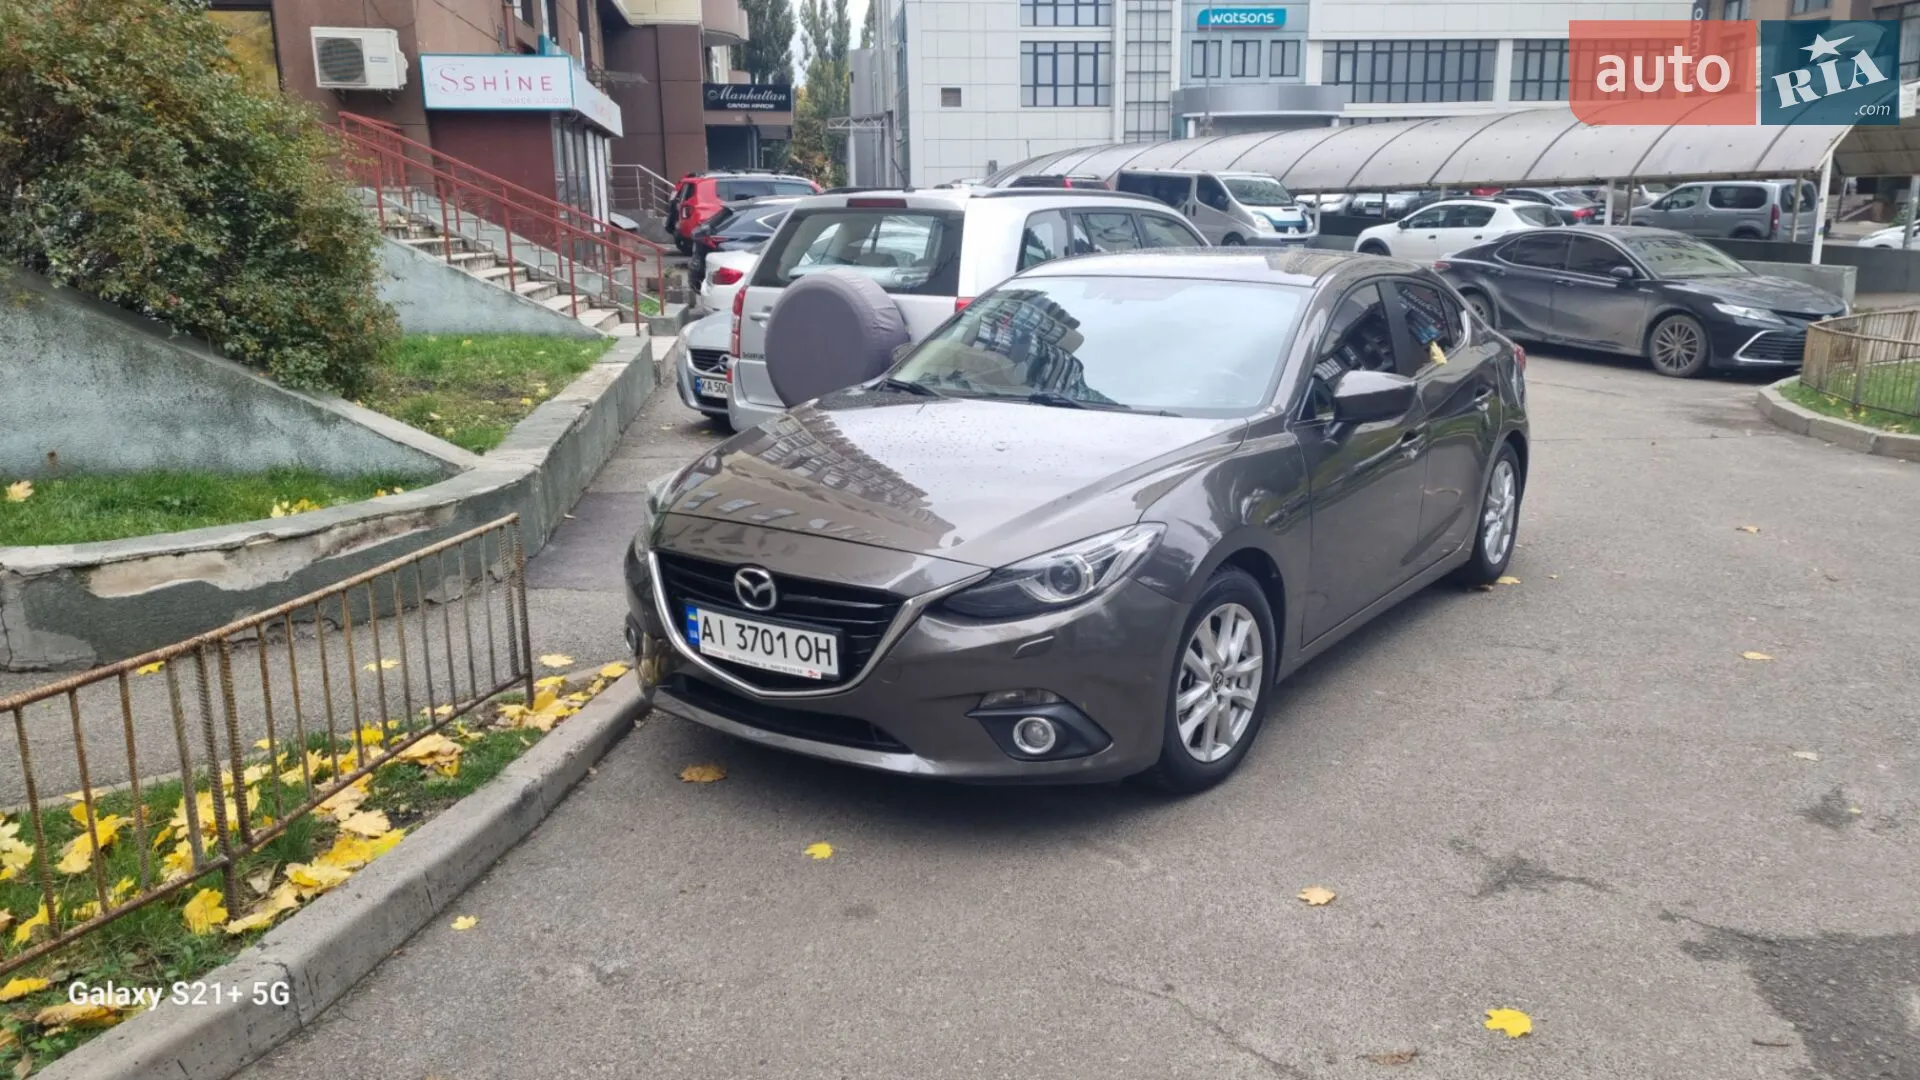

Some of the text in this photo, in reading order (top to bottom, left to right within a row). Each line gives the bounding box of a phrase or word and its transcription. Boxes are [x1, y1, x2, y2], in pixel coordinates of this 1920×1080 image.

[1210, 12, 1275, 24] watsons
[709, 85, 787, 101] Manhattan
[701, 615, 725, 647] AI
[735, 623, 788, 659] 3701
[795, 634, 832, 667] OH
